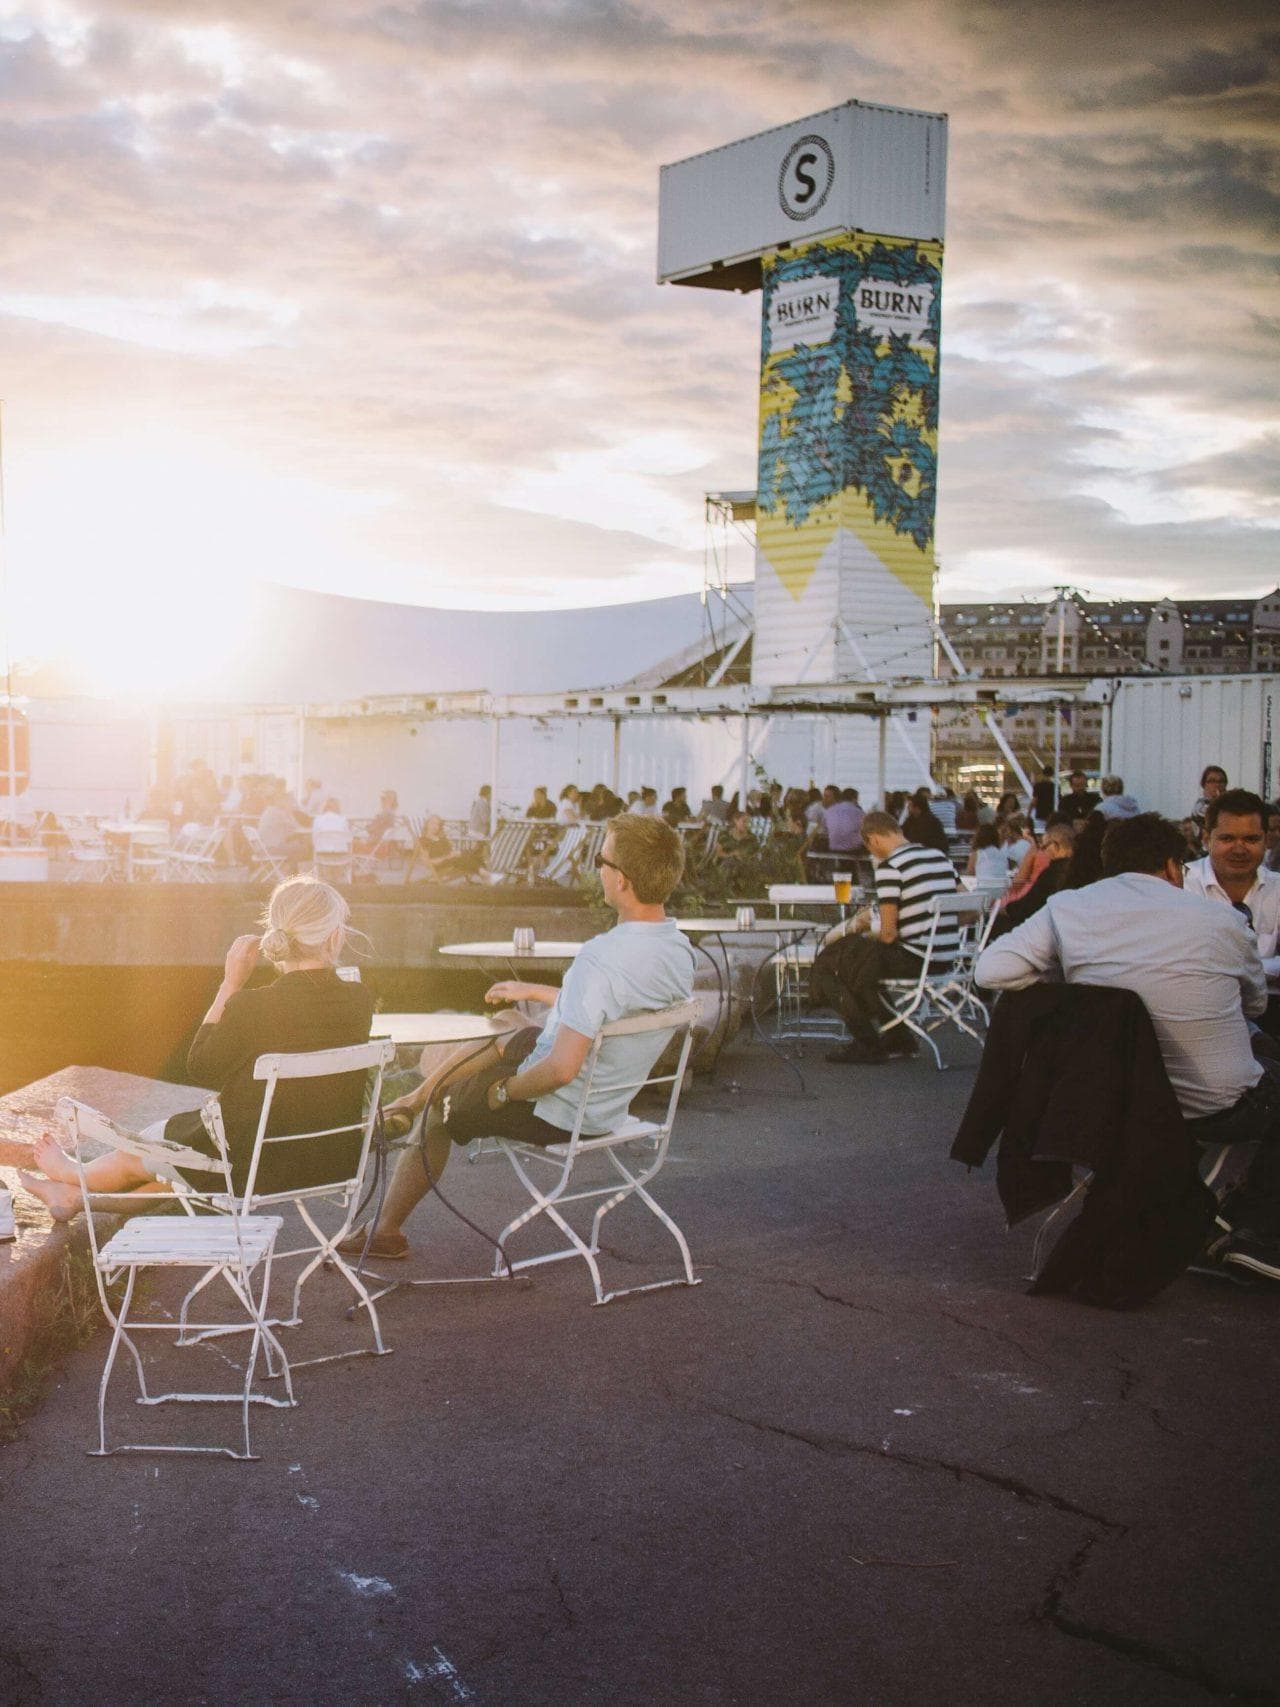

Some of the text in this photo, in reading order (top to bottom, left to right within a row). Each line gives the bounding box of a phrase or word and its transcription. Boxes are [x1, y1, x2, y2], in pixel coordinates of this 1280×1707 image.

[794, 153, 818, 203] S
[777, 292, 830, 321] BURN
[861, 289, 923, 315] BURN
